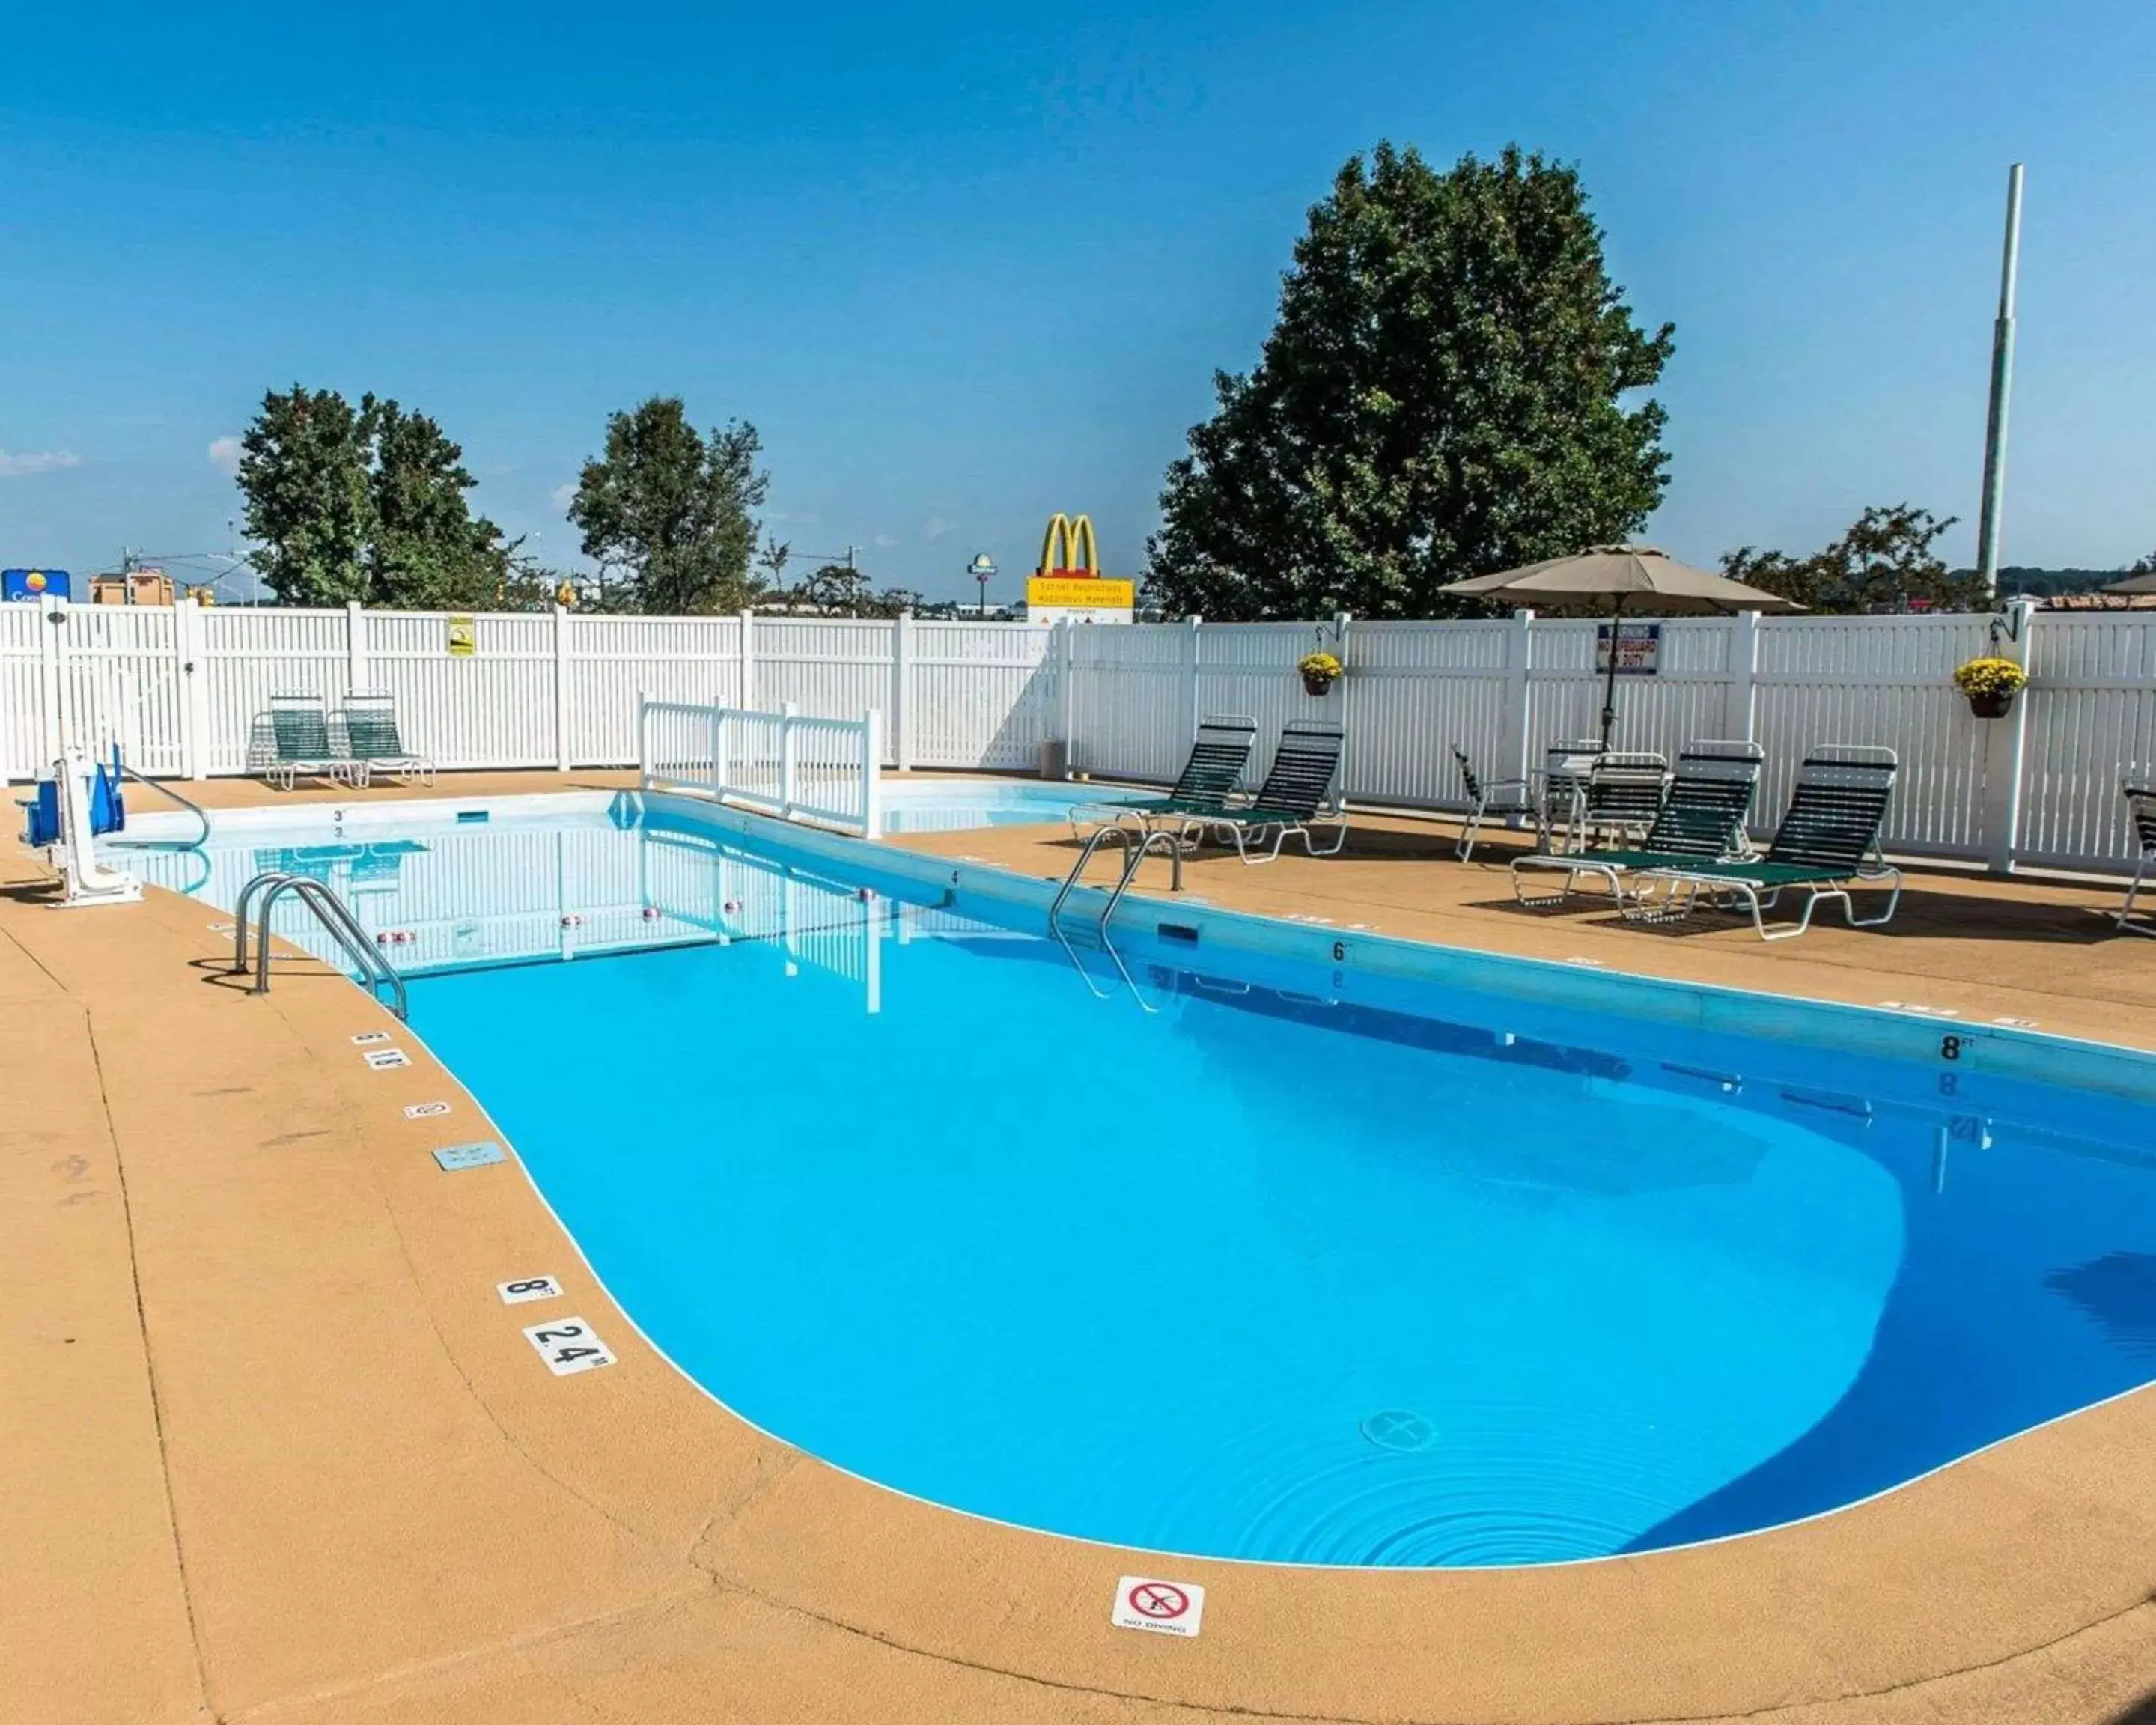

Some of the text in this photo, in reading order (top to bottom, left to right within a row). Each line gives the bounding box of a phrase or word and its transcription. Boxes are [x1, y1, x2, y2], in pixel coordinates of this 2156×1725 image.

[1607, 625, 1649, 638] WRNING
[1613, 640, 1656, 652] IFEGUARD
[334, 809, 343, 822] 3
[1333, 941, 1345, 961] 6
[1941, 1035, 1960, 1060] 8
[507, 1279, 549, 1294] 8
[1123, 1619, 1187, 1634] NO DIVING
